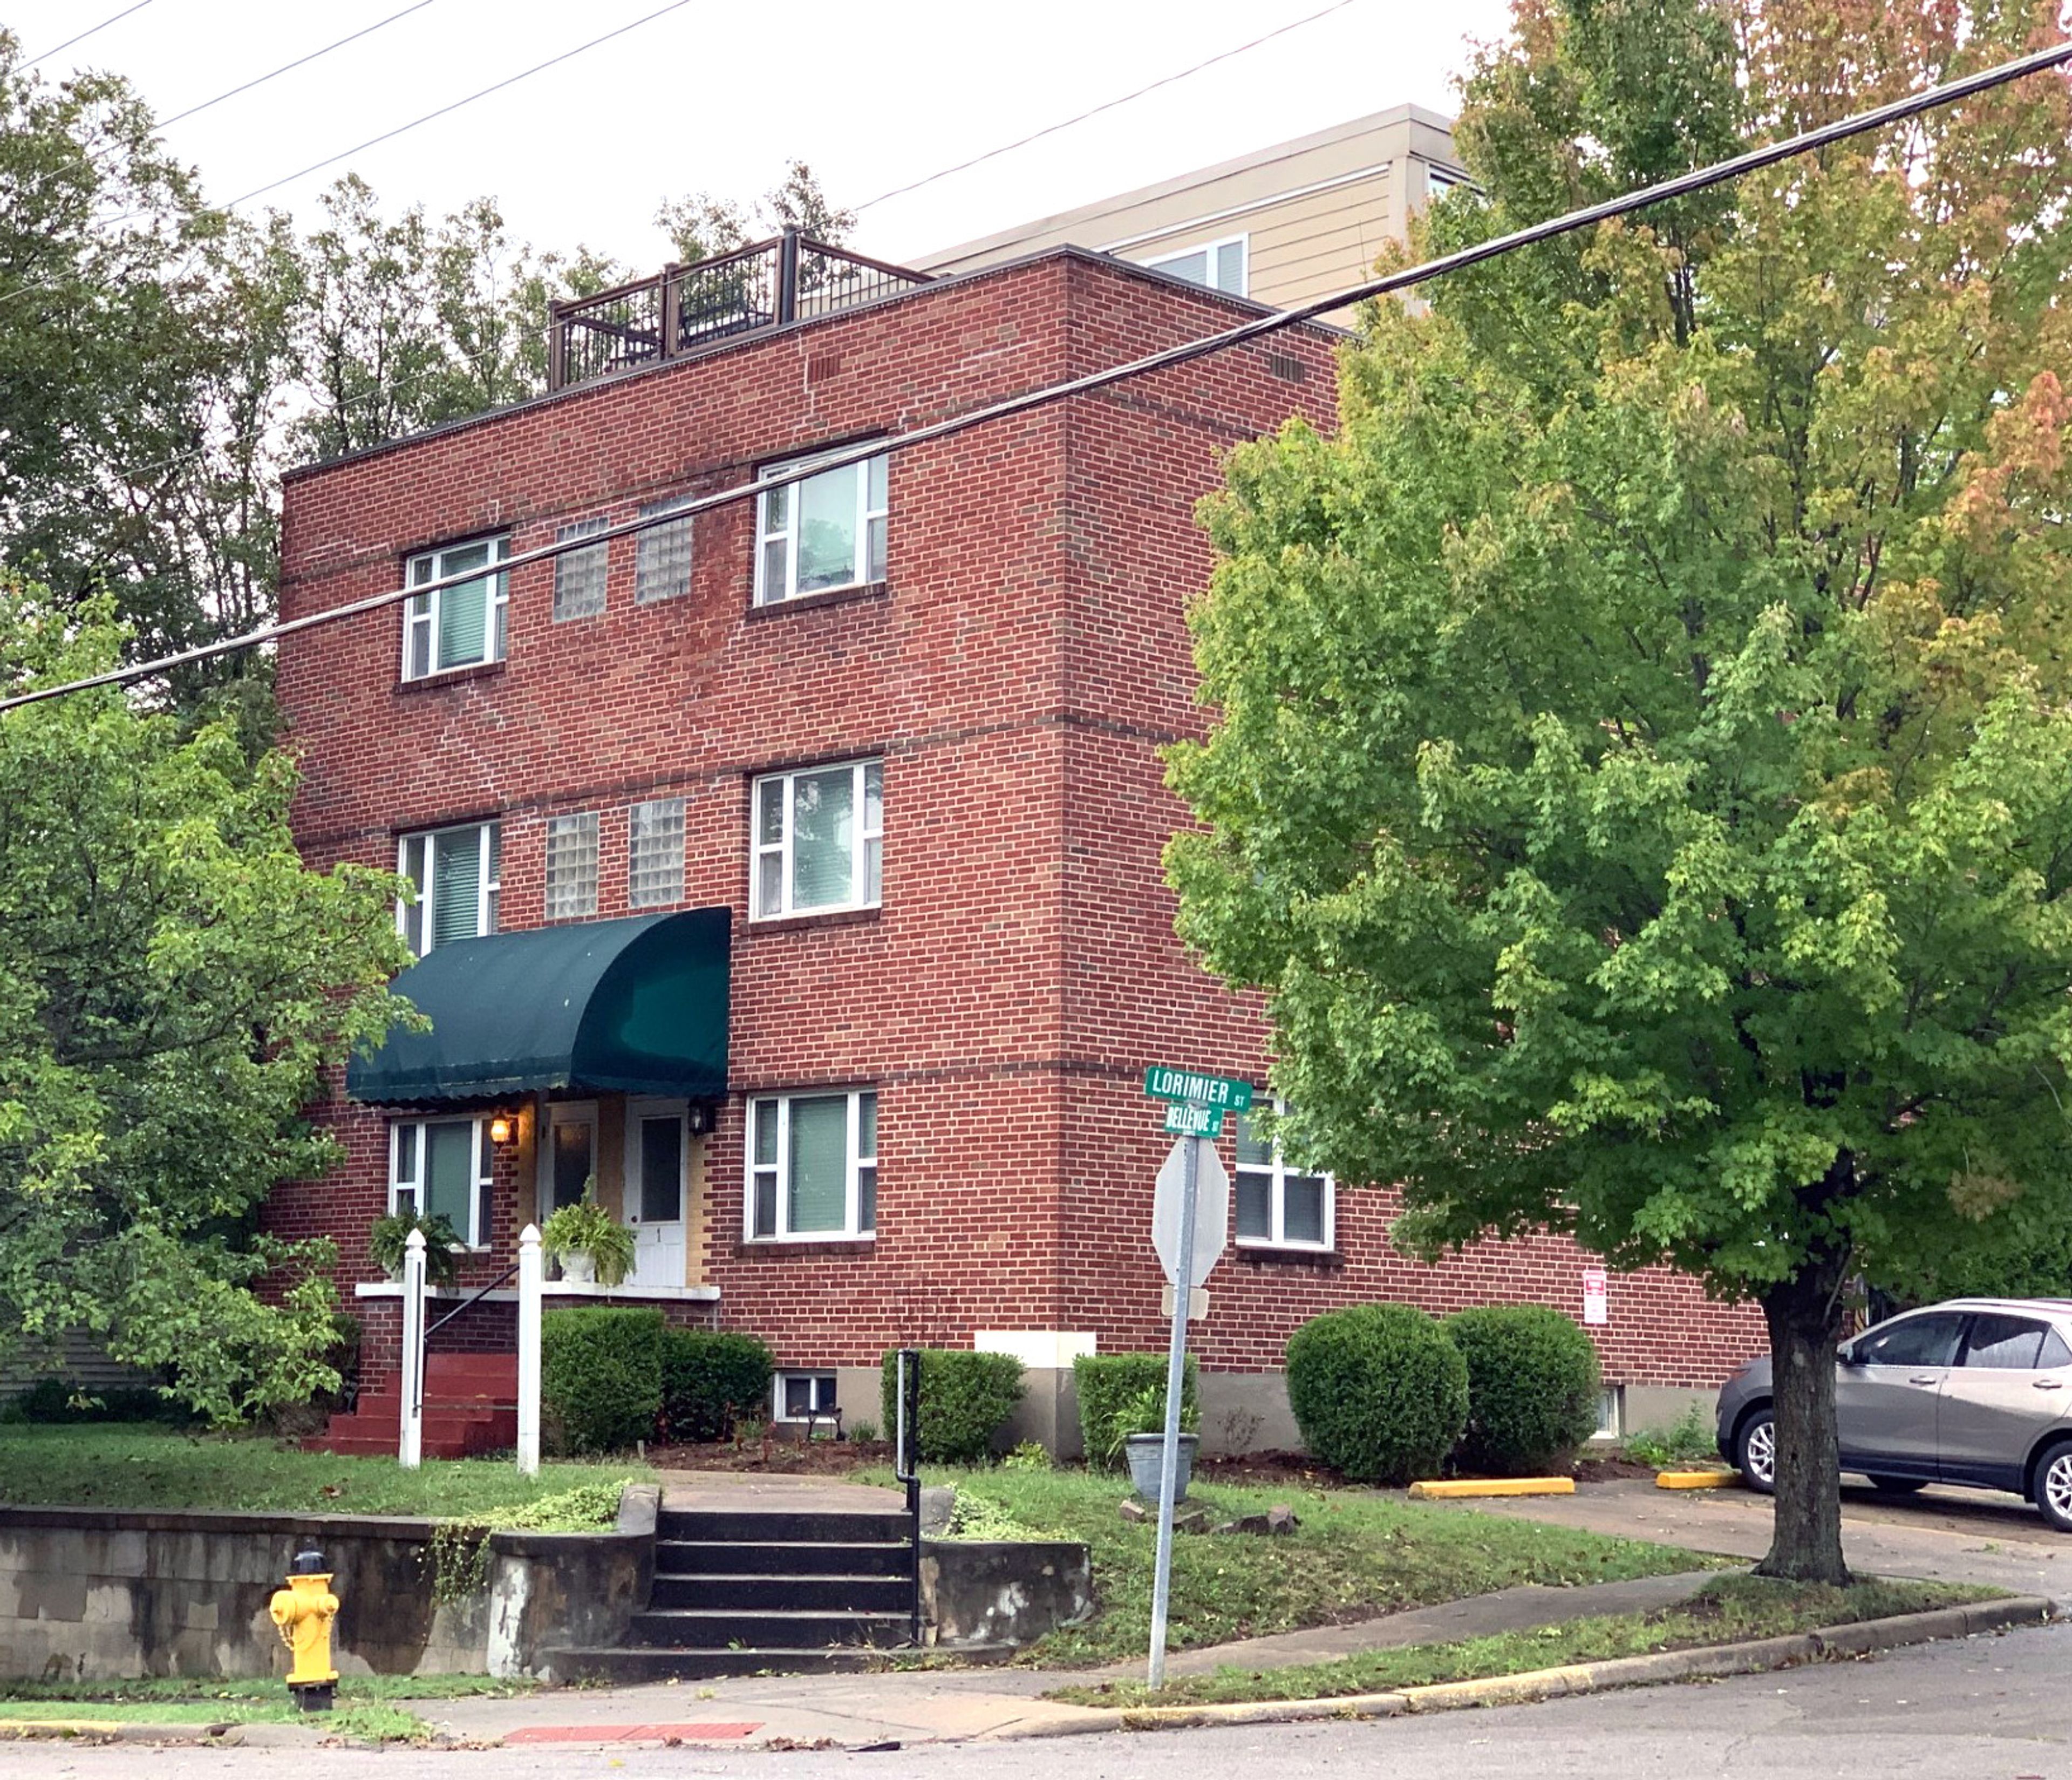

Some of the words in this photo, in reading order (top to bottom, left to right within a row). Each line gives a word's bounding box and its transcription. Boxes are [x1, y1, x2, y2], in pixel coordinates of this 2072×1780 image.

[1152, 1069, 1229, 1104] LORIMIER
[1233, 1095, 1246, 1107] ST
[1166, 1106, 1212, 1132] BELLEVUE
